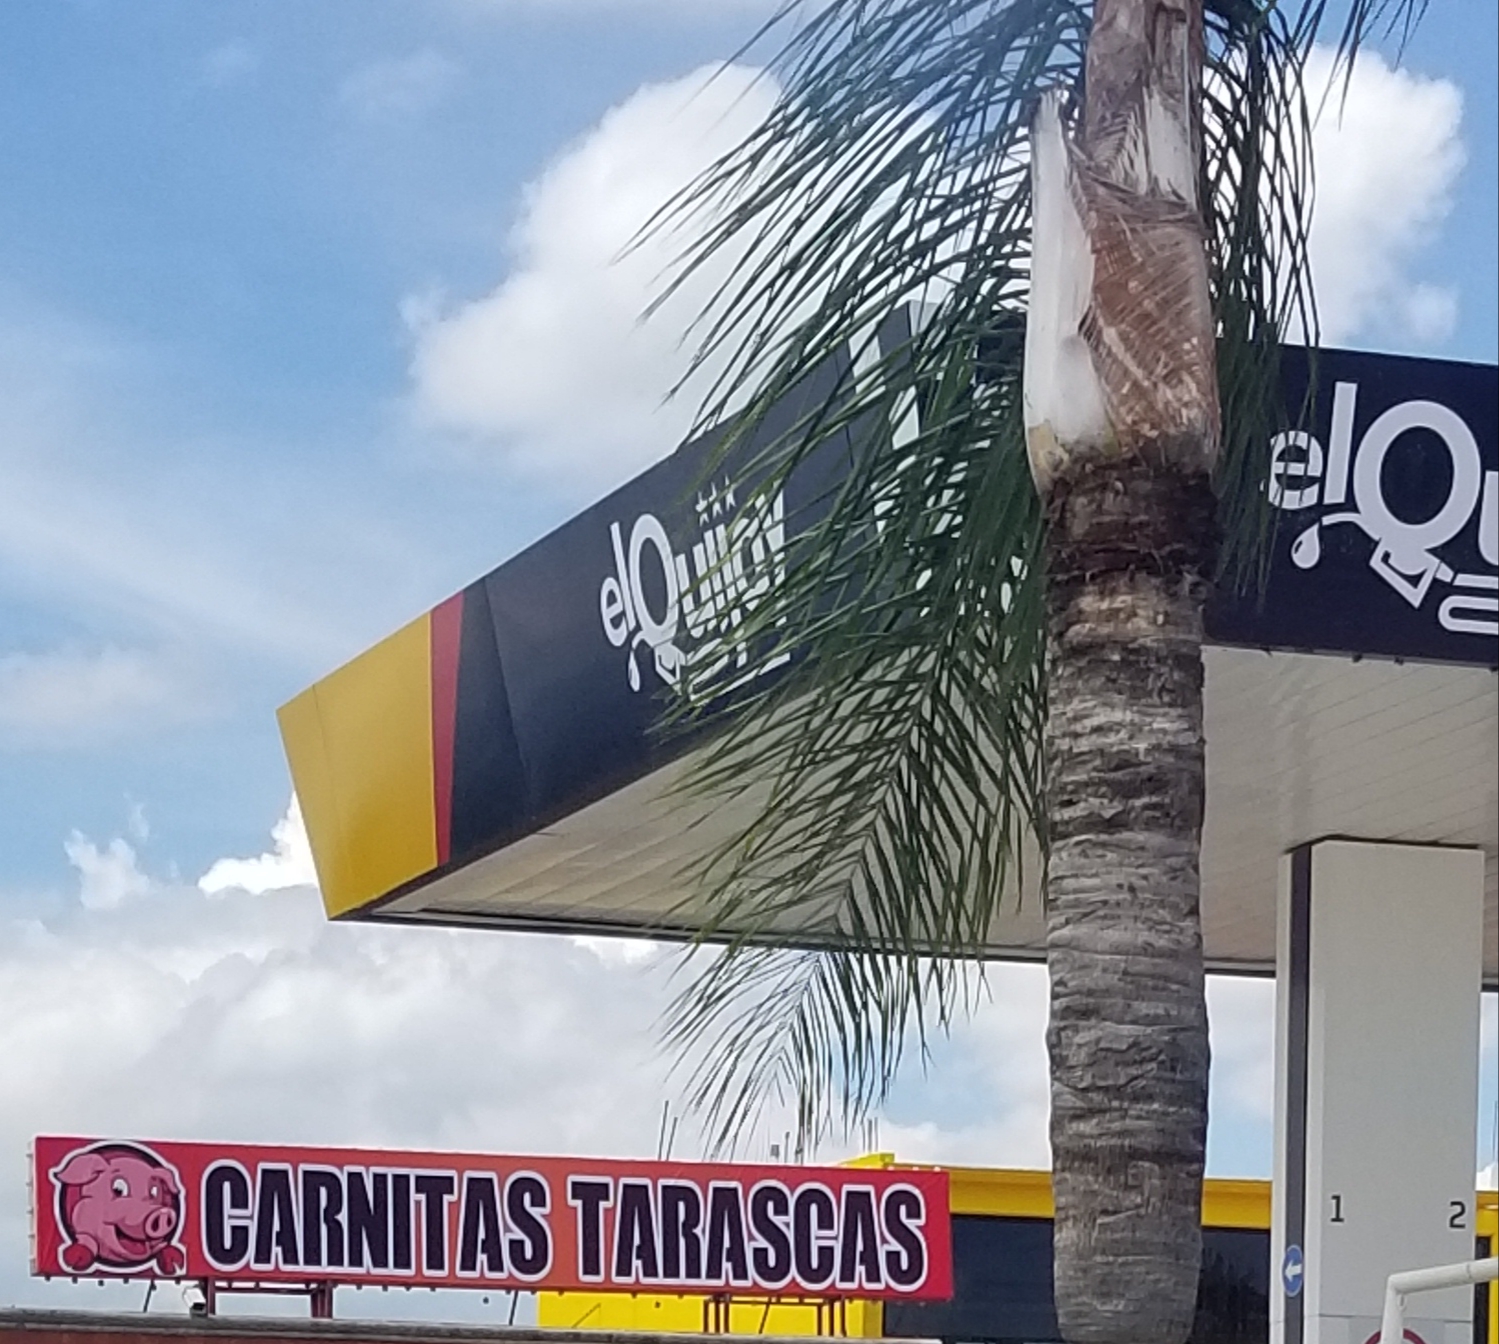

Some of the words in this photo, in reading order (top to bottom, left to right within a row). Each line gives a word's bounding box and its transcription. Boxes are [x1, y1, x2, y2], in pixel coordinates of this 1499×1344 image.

[1330, 1195, 1345, 1223] 1
[1449, 1201, 1467, 1229] 2
[203, 1161, 550, 1280] CARNITAS
[569, 1173, 928, 1290] TARASCAS
